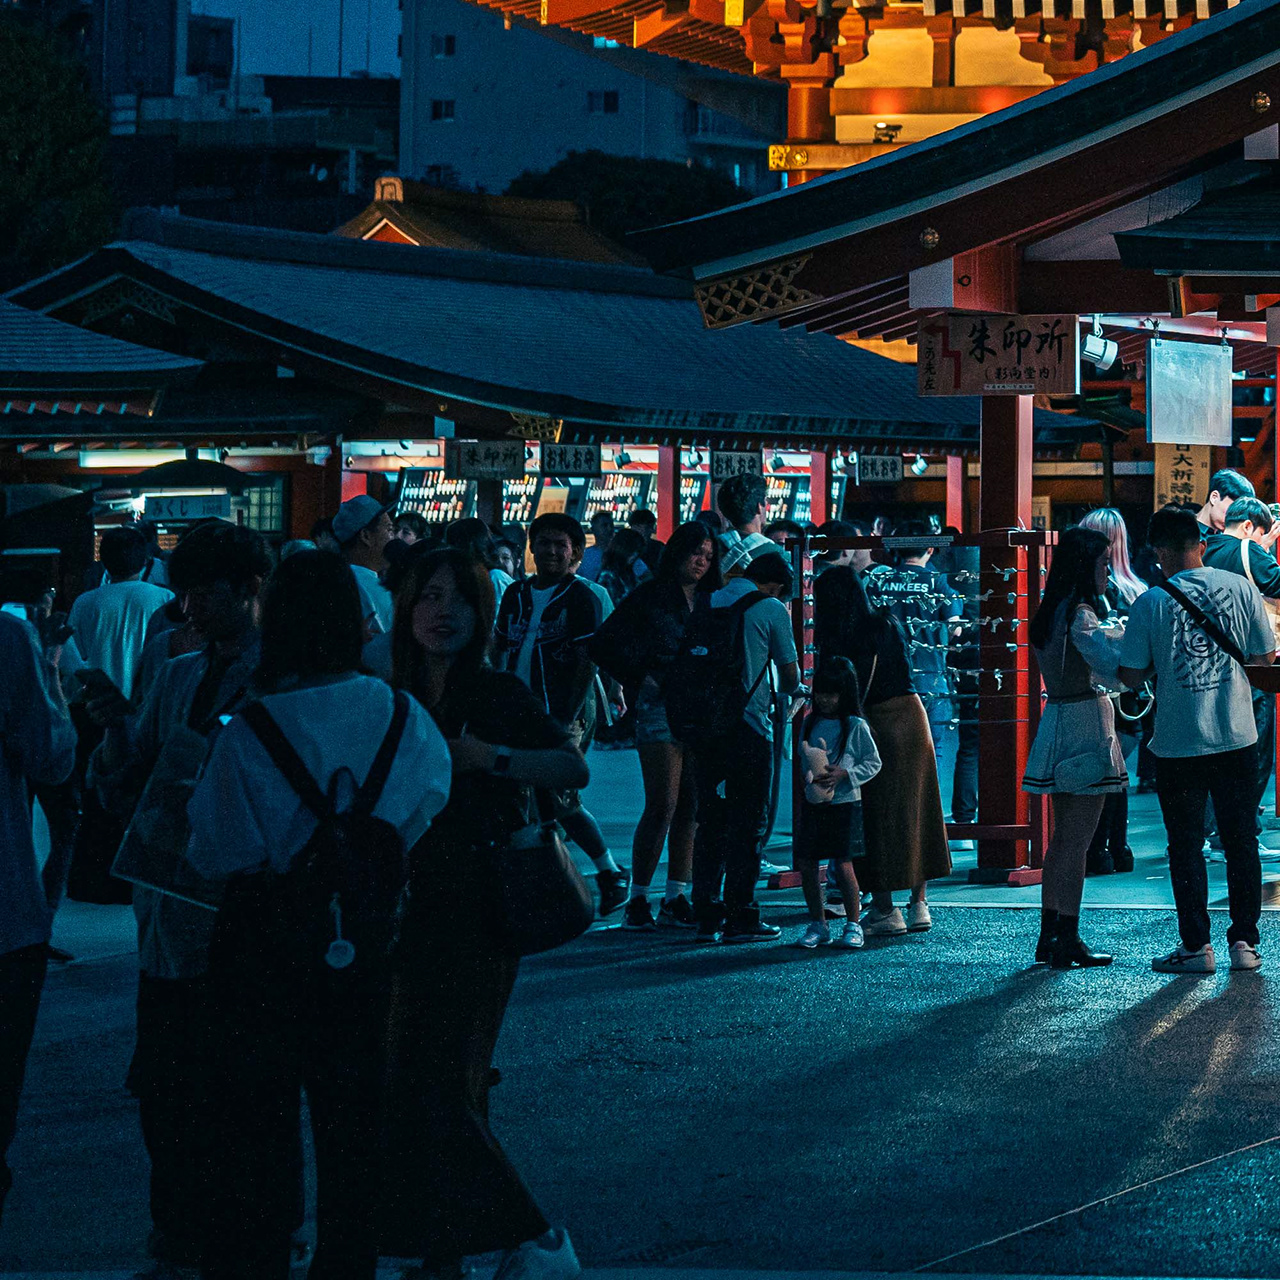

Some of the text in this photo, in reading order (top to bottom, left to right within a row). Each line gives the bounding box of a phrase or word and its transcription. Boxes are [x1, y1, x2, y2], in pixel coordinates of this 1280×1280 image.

[968, 320, 1069, 366] 朱印所
[876, 582, 929, 592] ANKEES
